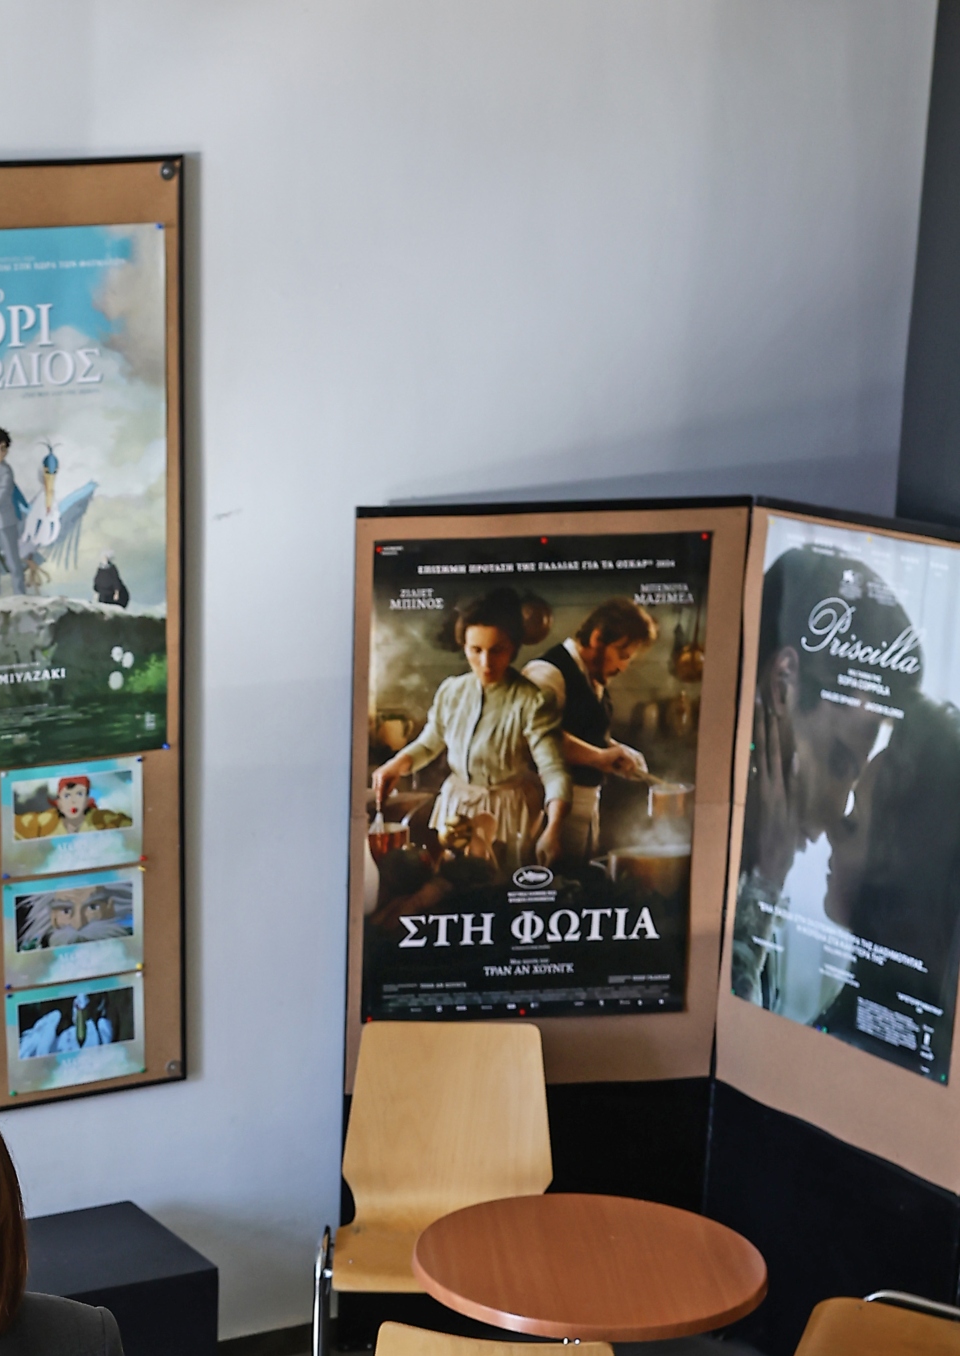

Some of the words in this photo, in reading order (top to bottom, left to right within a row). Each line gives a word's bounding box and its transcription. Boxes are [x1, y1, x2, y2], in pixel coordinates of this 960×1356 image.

[800, 596, 928, 675] Priscilla
[398, 912, 496, 948] ΣΤΗ
[510, 906, 661, 945] ΦΩΤΙΑ
